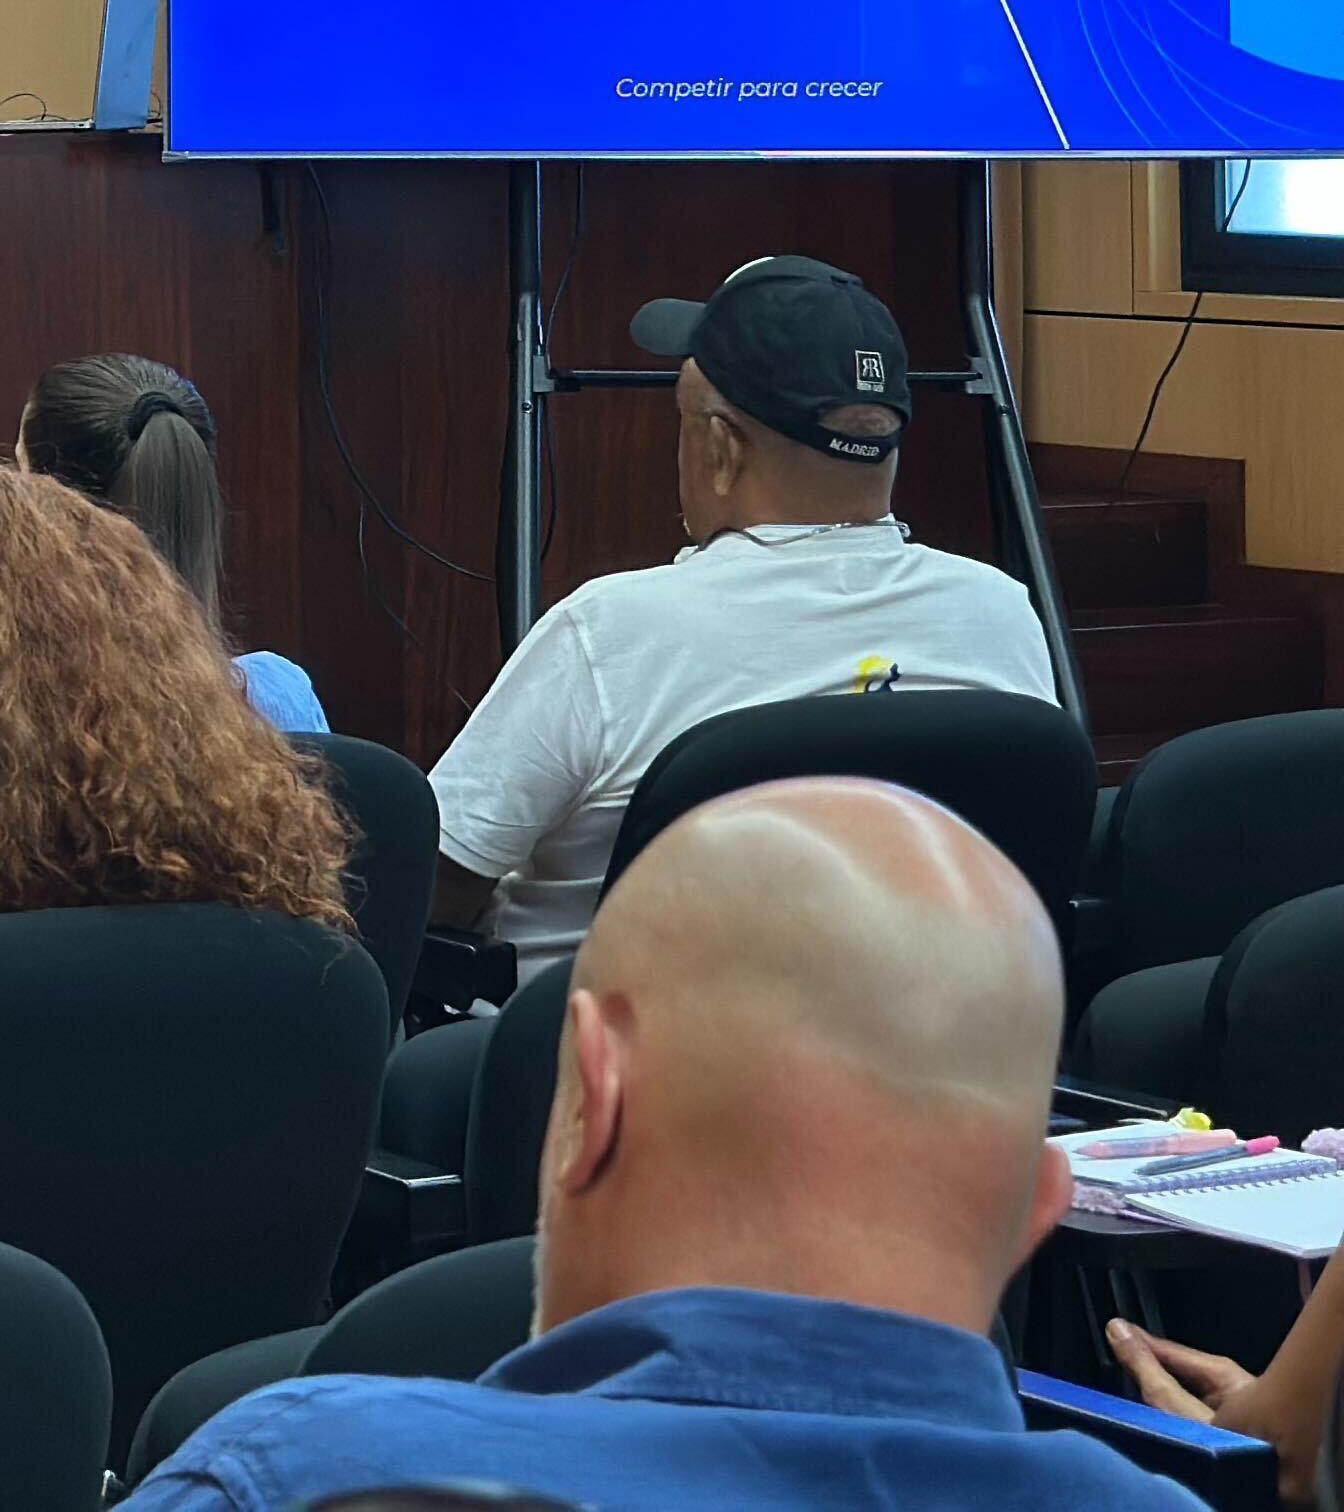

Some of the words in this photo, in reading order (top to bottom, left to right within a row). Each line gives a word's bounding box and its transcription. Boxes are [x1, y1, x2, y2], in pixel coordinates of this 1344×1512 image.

[615, 77, 734, 103] Competir
[736, 82, 799, 102] para
[805, 81, 884, 97] crecer
